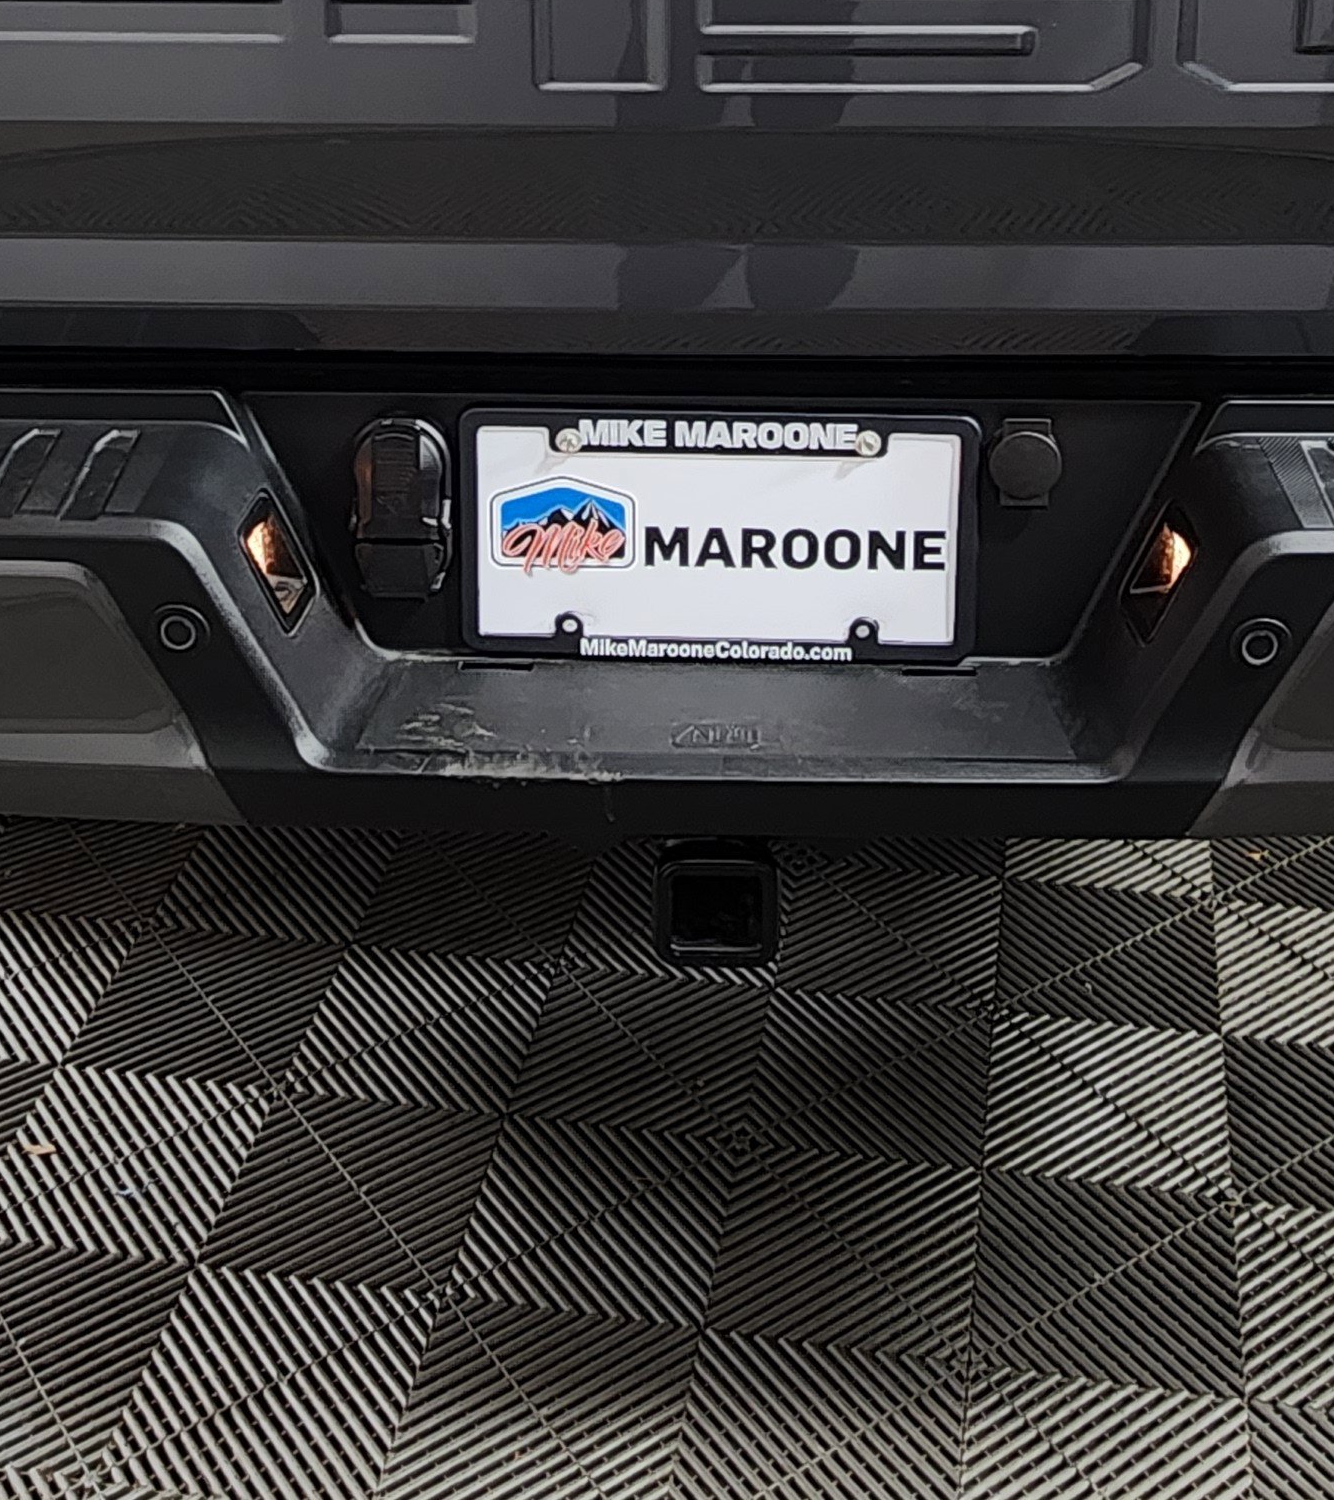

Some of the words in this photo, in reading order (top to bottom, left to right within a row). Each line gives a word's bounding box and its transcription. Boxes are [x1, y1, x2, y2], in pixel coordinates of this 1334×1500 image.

[578, 419, 667, 448] MIKE
[674, 421, 857, 451] MAROONE
[500, 517, 627, 575] Mike
[643, 526, 948, 571] MAROONE
[579, 638, 853, 662] MikeMarooneColorado.com
